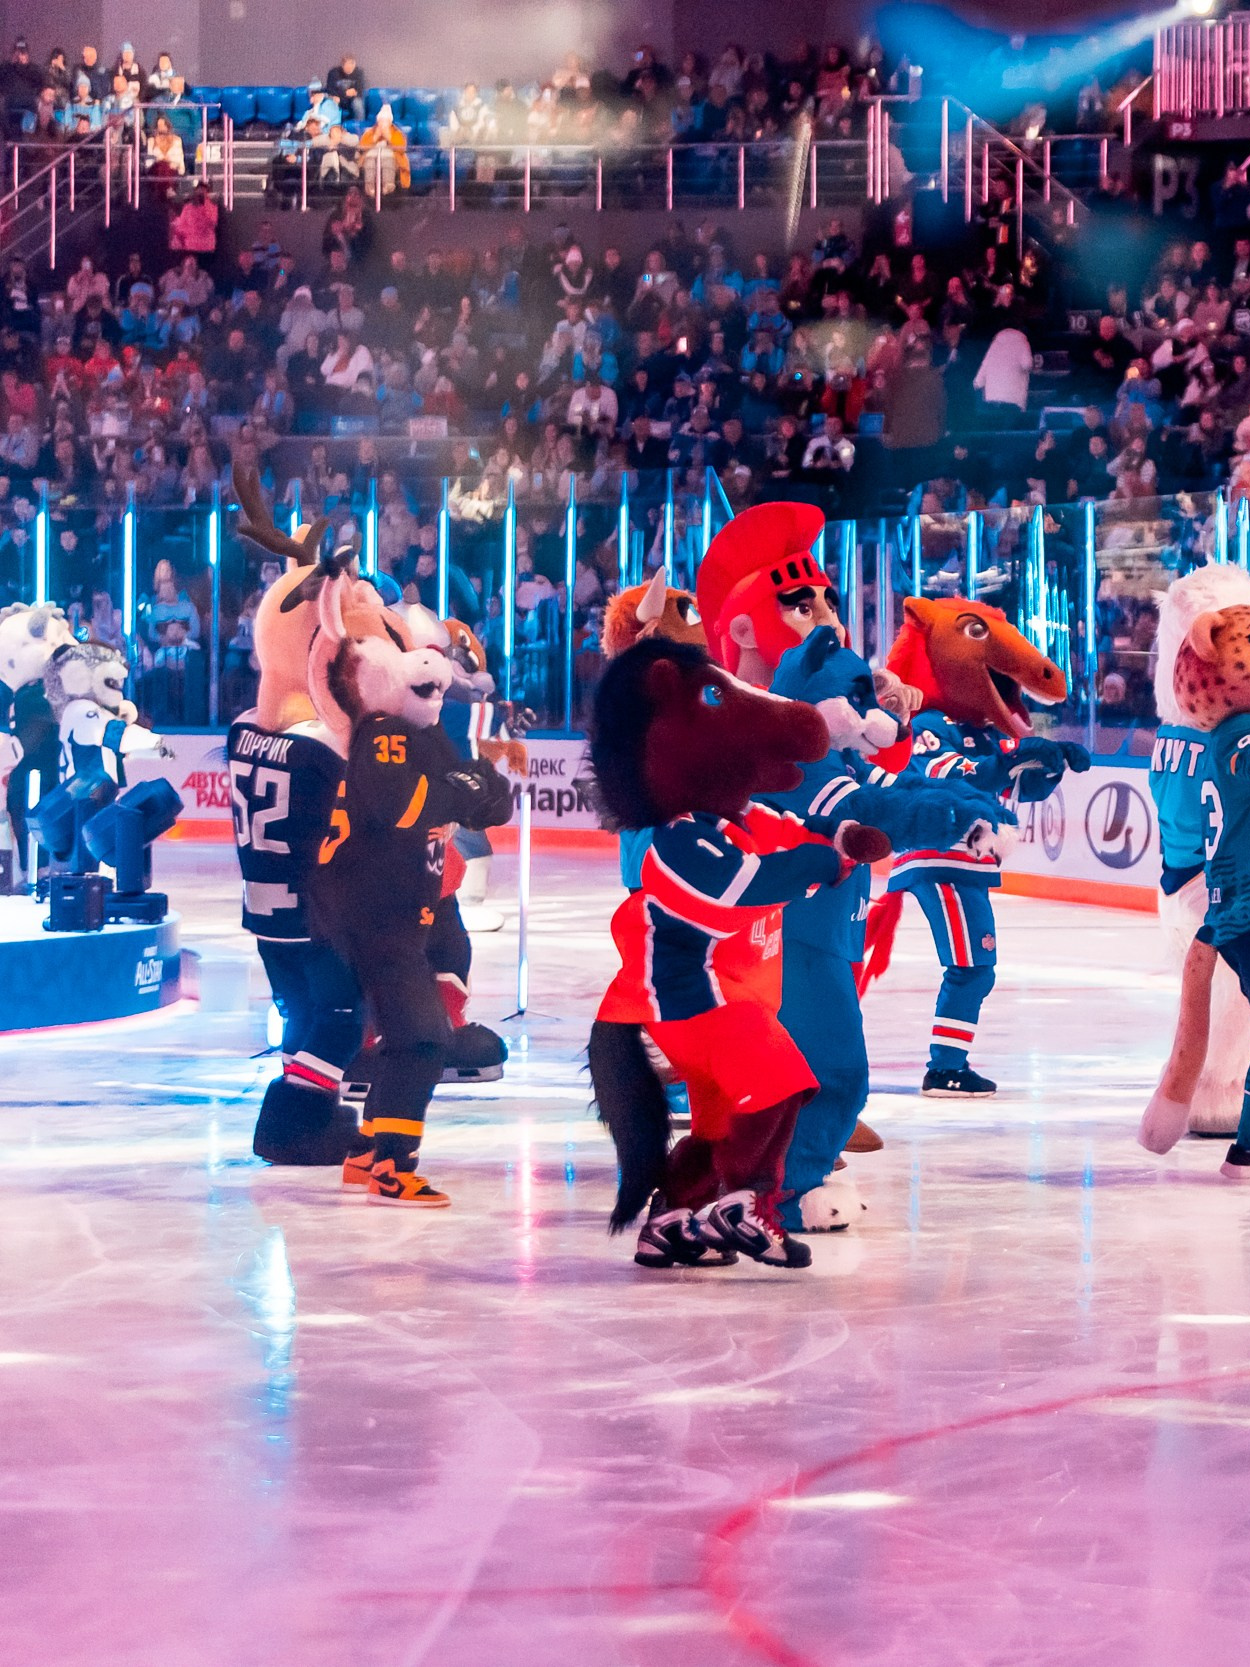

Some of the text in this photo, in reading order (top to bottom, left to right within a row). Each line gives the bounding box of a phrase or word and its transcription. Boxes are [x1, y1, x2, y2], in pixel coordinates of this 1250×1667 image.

[235, 729, 294, 764] ТОРРИК
[373, 734, 407, 764] 35
[512, 757, 567, 778] декс
[229, 759, 291, 855] 52
